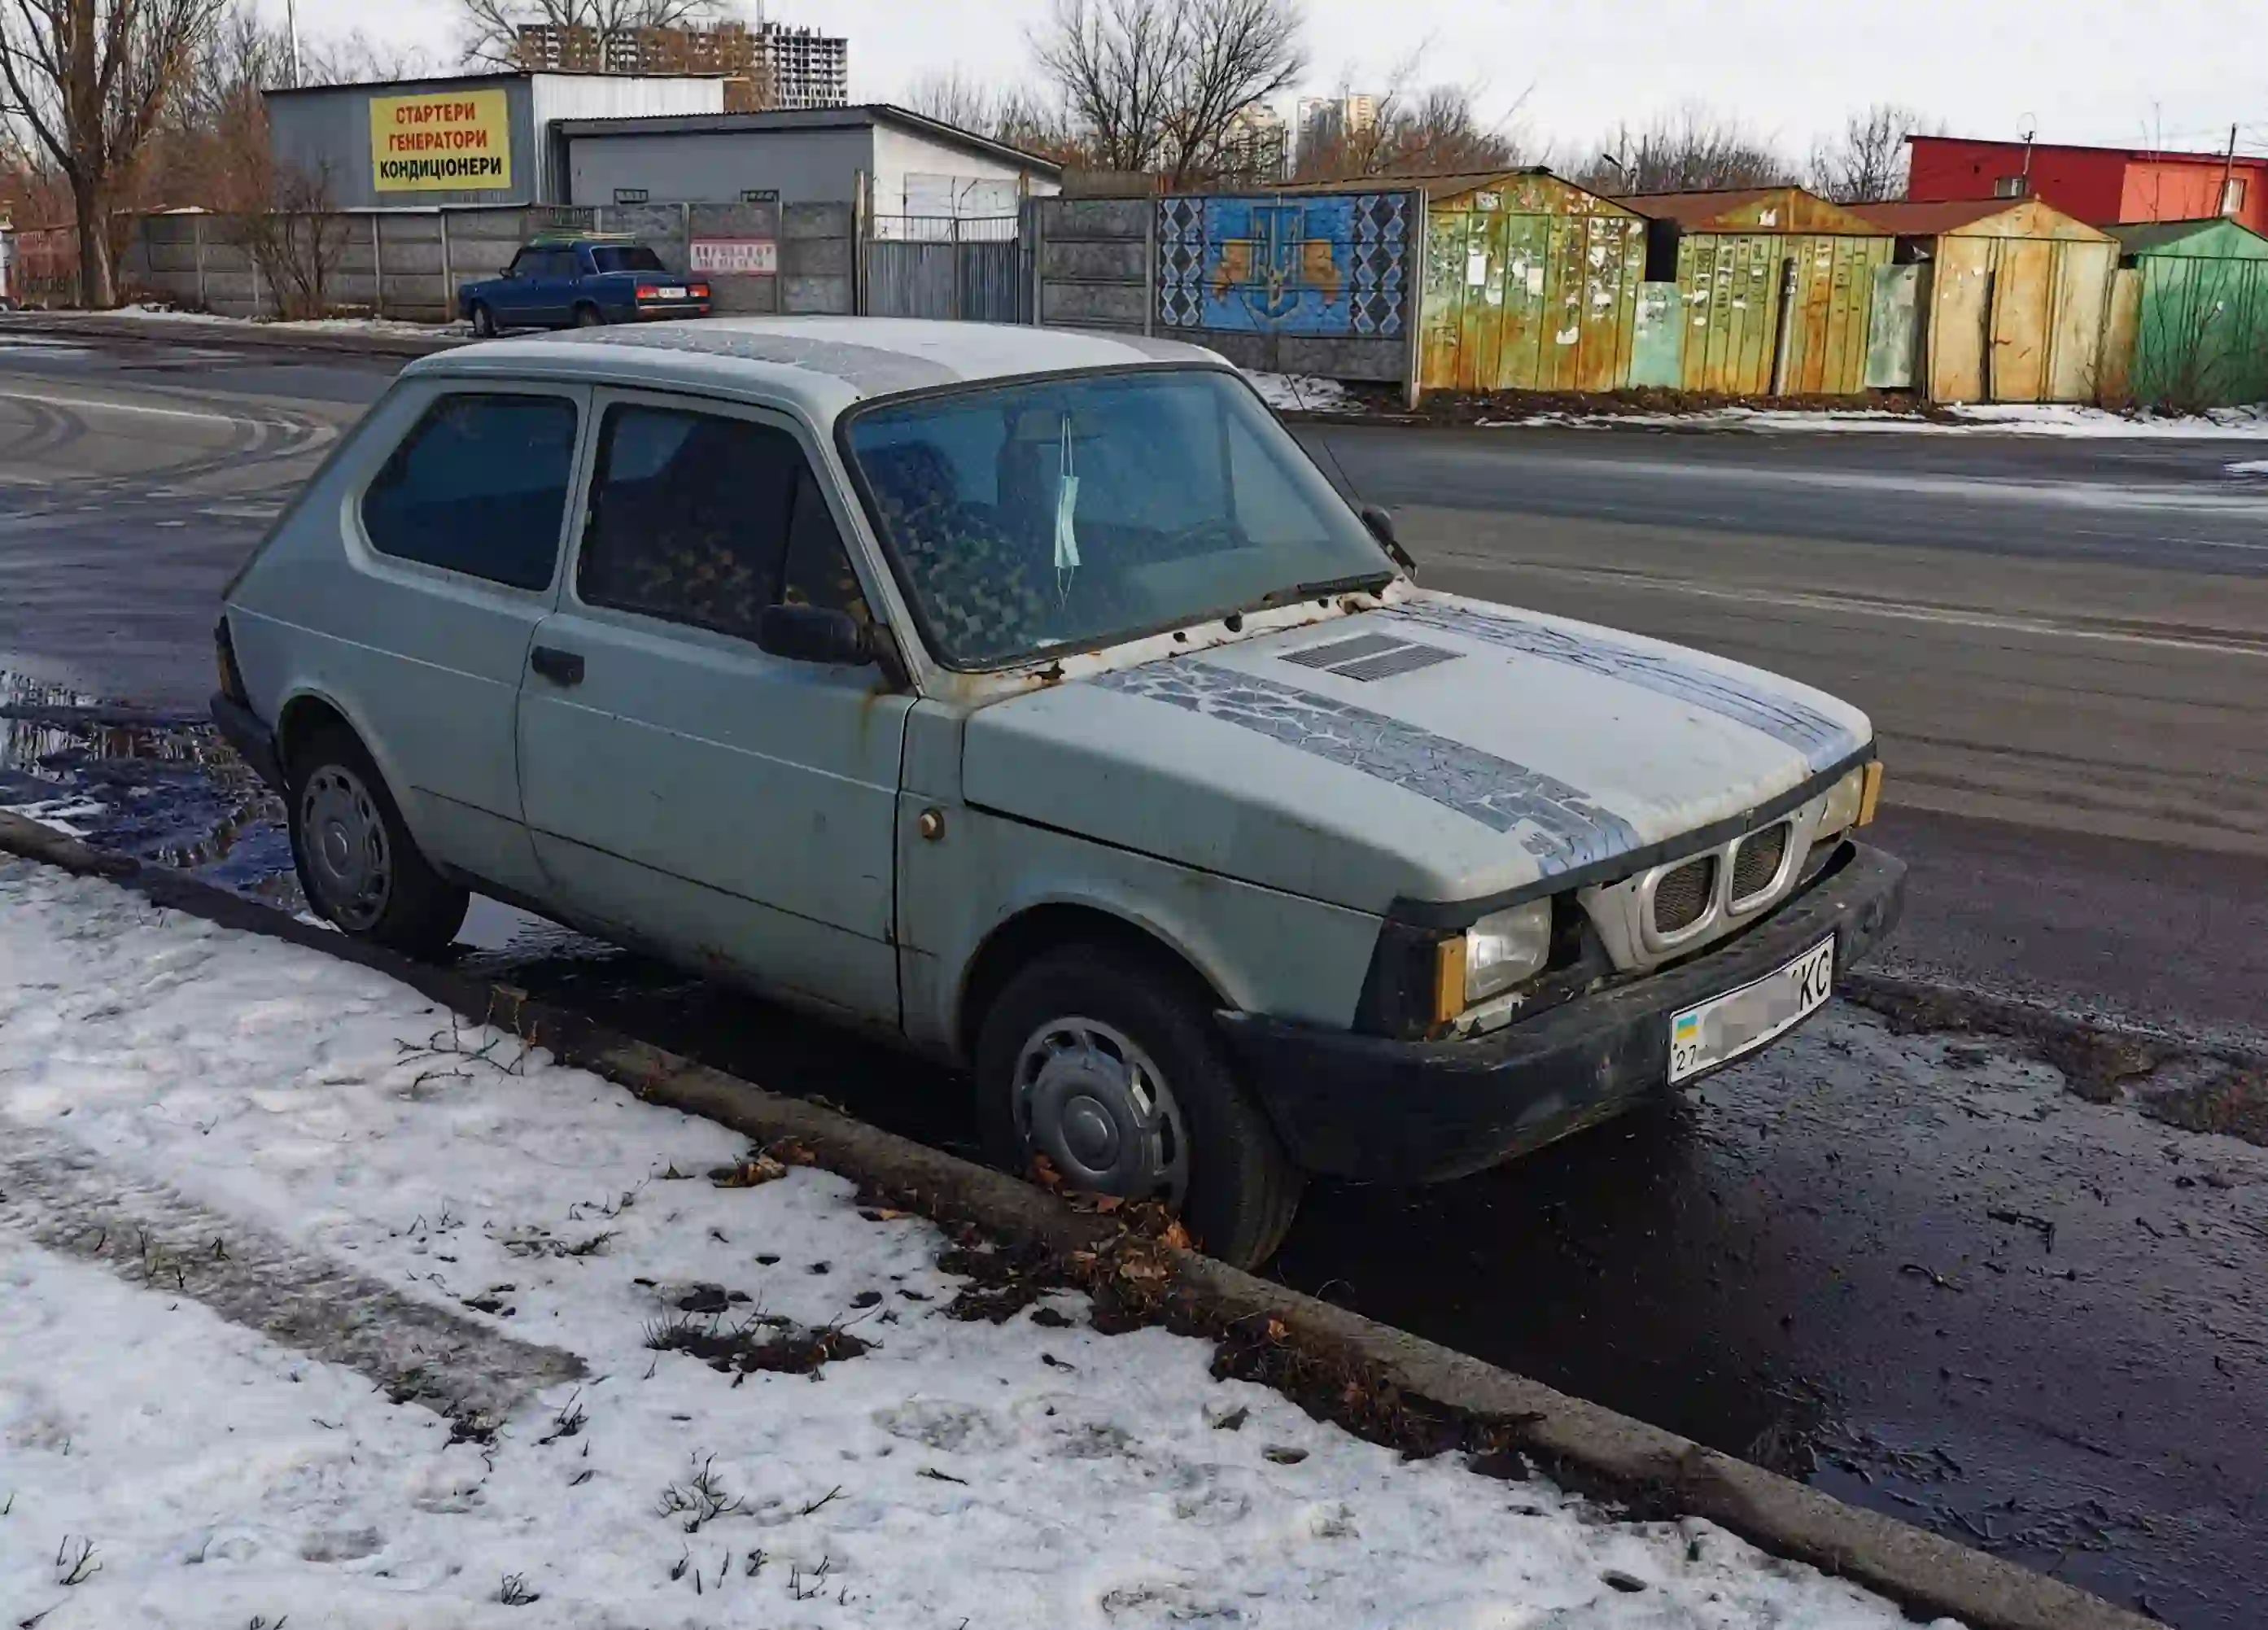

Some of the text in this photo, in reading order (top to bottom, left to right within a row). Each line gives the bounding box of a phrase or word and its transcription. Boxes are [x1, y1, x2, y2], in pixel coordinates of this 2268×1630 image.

[396, 103, 475, 124] СТАРТЕРИ
[389, 129, 487, 152] ГЕНЕРАТОРИ
[380, 157, 501, 181] КОНДИЦІОНЕРИ
